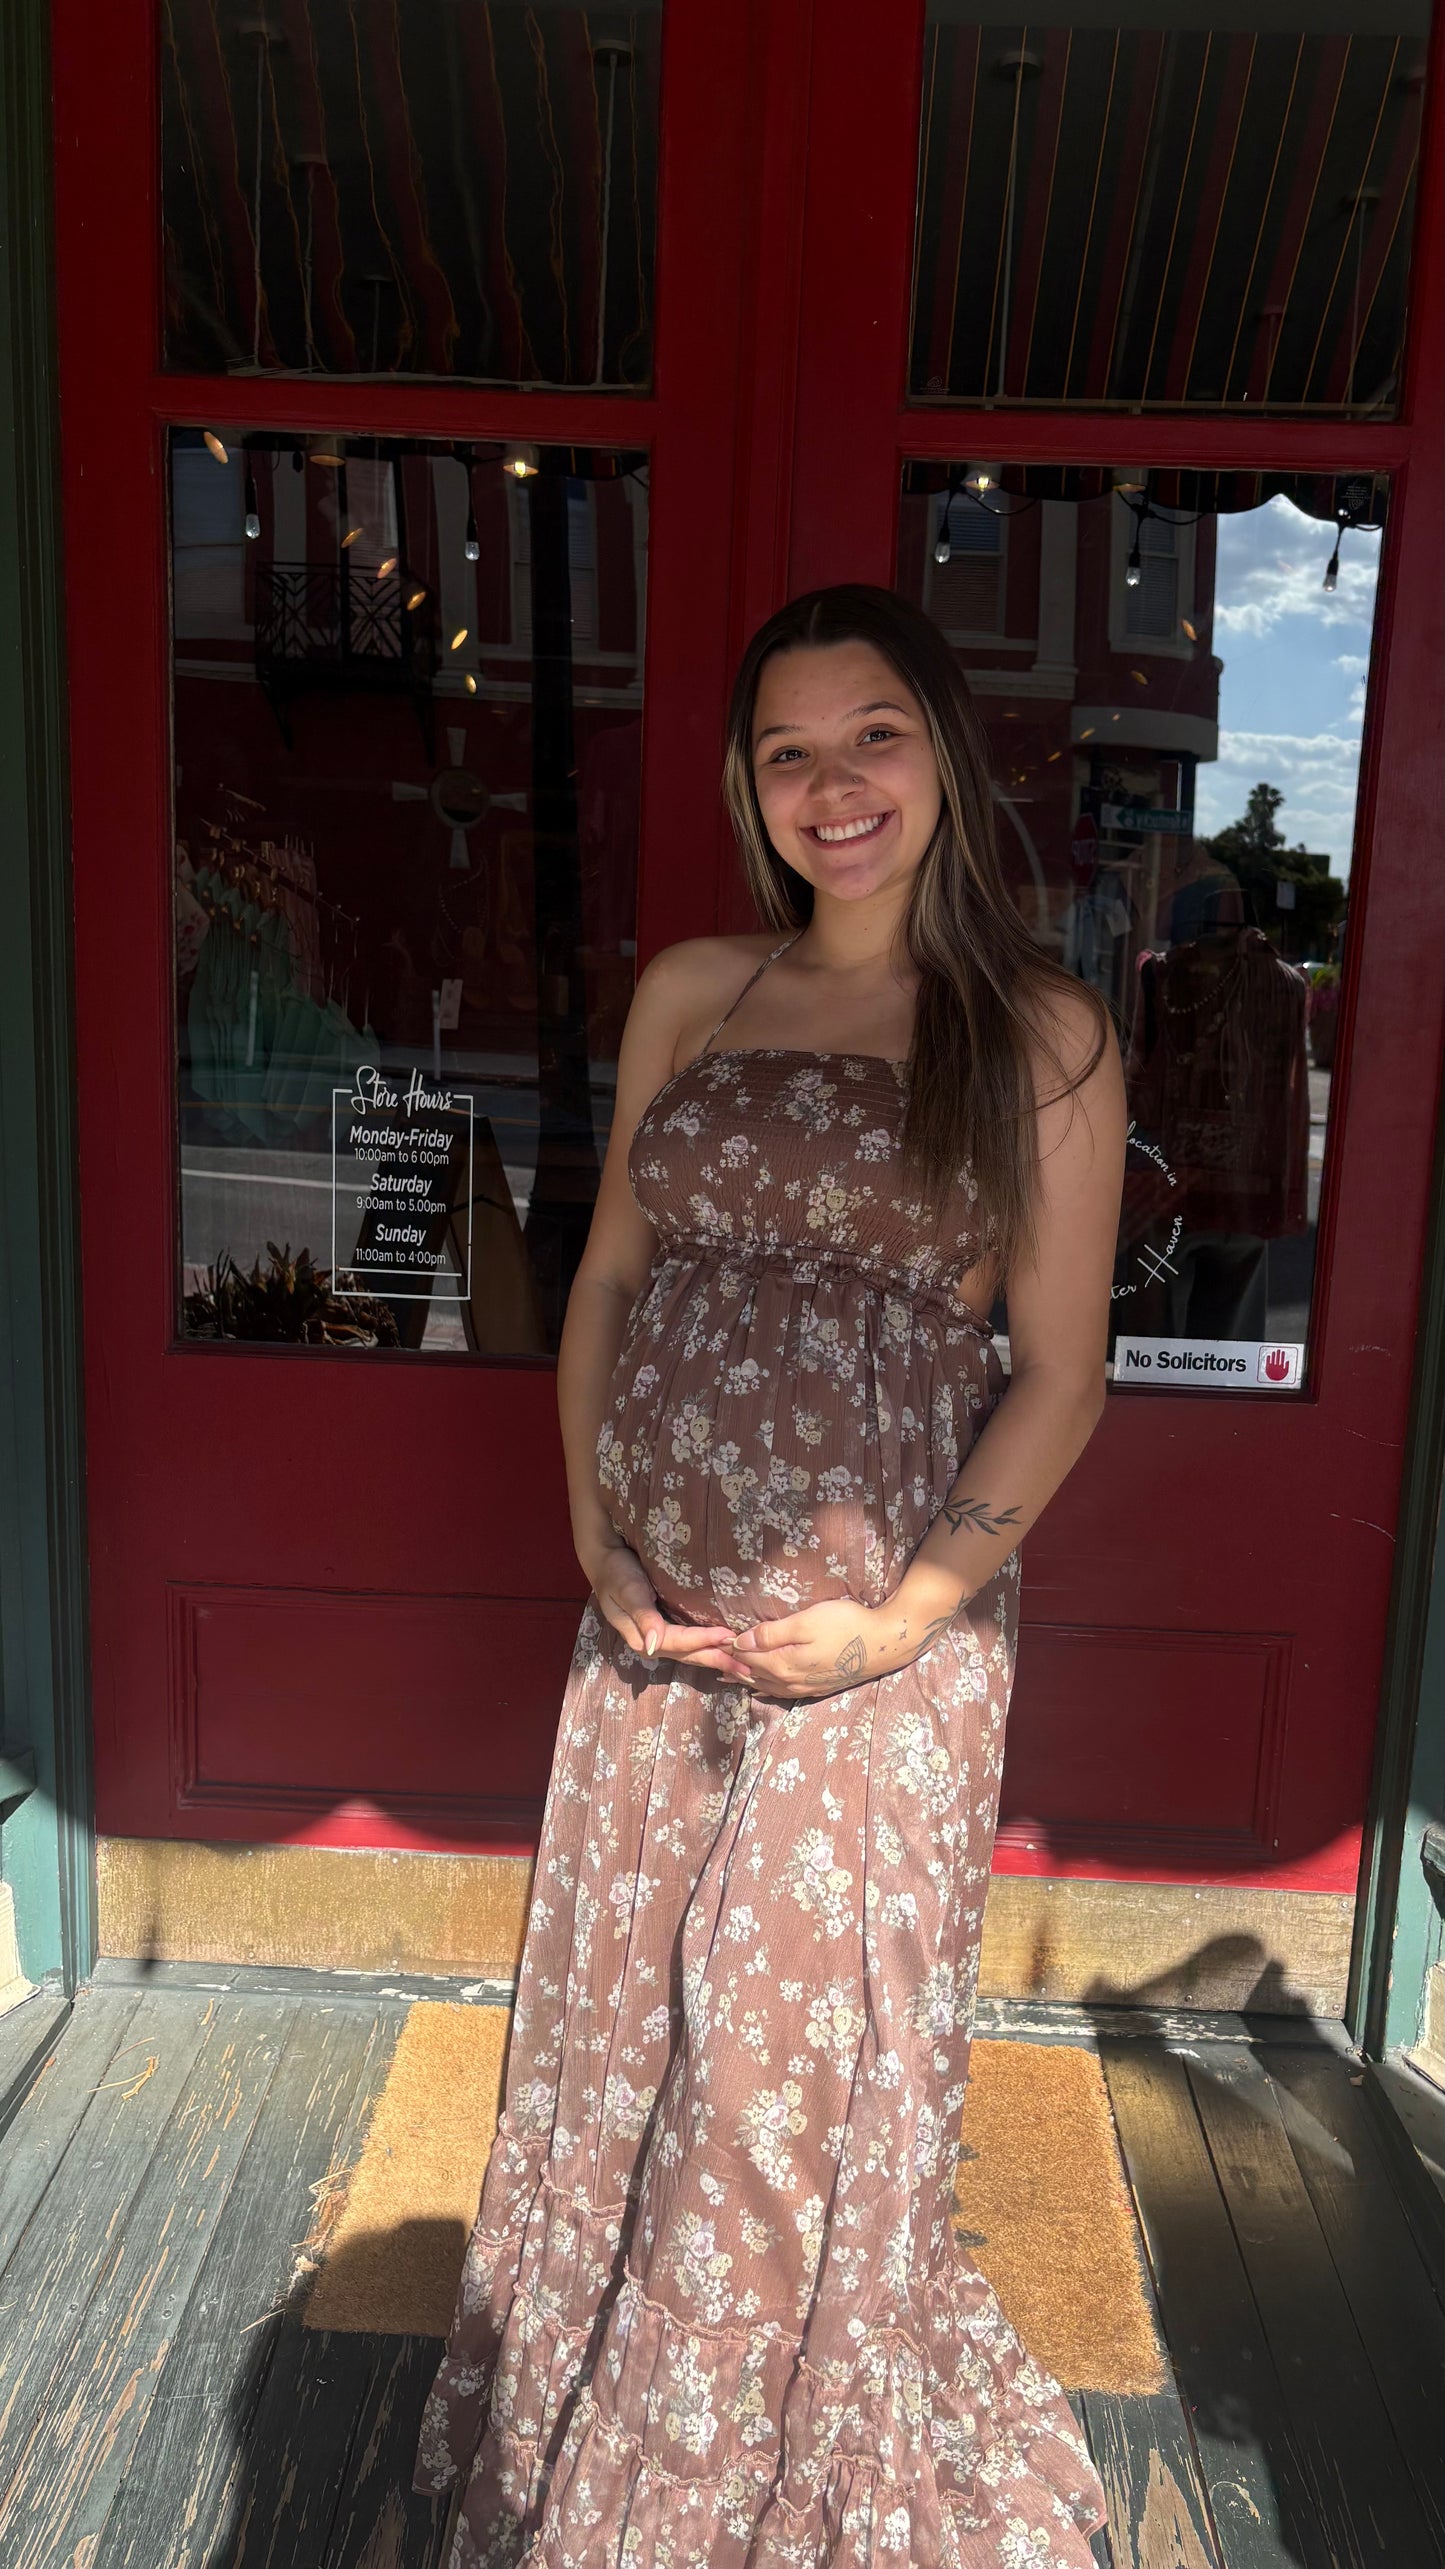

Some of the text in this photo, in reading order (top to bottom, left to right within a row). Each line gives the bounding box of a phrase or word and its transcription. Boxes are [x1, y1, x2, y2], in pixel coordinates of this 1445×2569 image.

[351, 1065, 453, 1118] Store Hours
[350, 1125, 454, 1152] Monday-Friday
[355, 1147, 396, 1163] 10:00am
[399, 1150, 409, 1163] to
[1126, 1120, 1177, 1188] location in
[370, 1173, 433, 1197] Saturday
[356, 1196, 394, 1211] 9:00am
[396, 1198, 406, 1211] to
[375, 1223, 427, 1247] Sunday
[356, 1248, 393, 1263] 11:00am
[396, 1250, 406, 1263] to
[1110, 1215, 1183, 1299] ter Haven
[1125, 1349, 1247, 1372] No Solicitors
